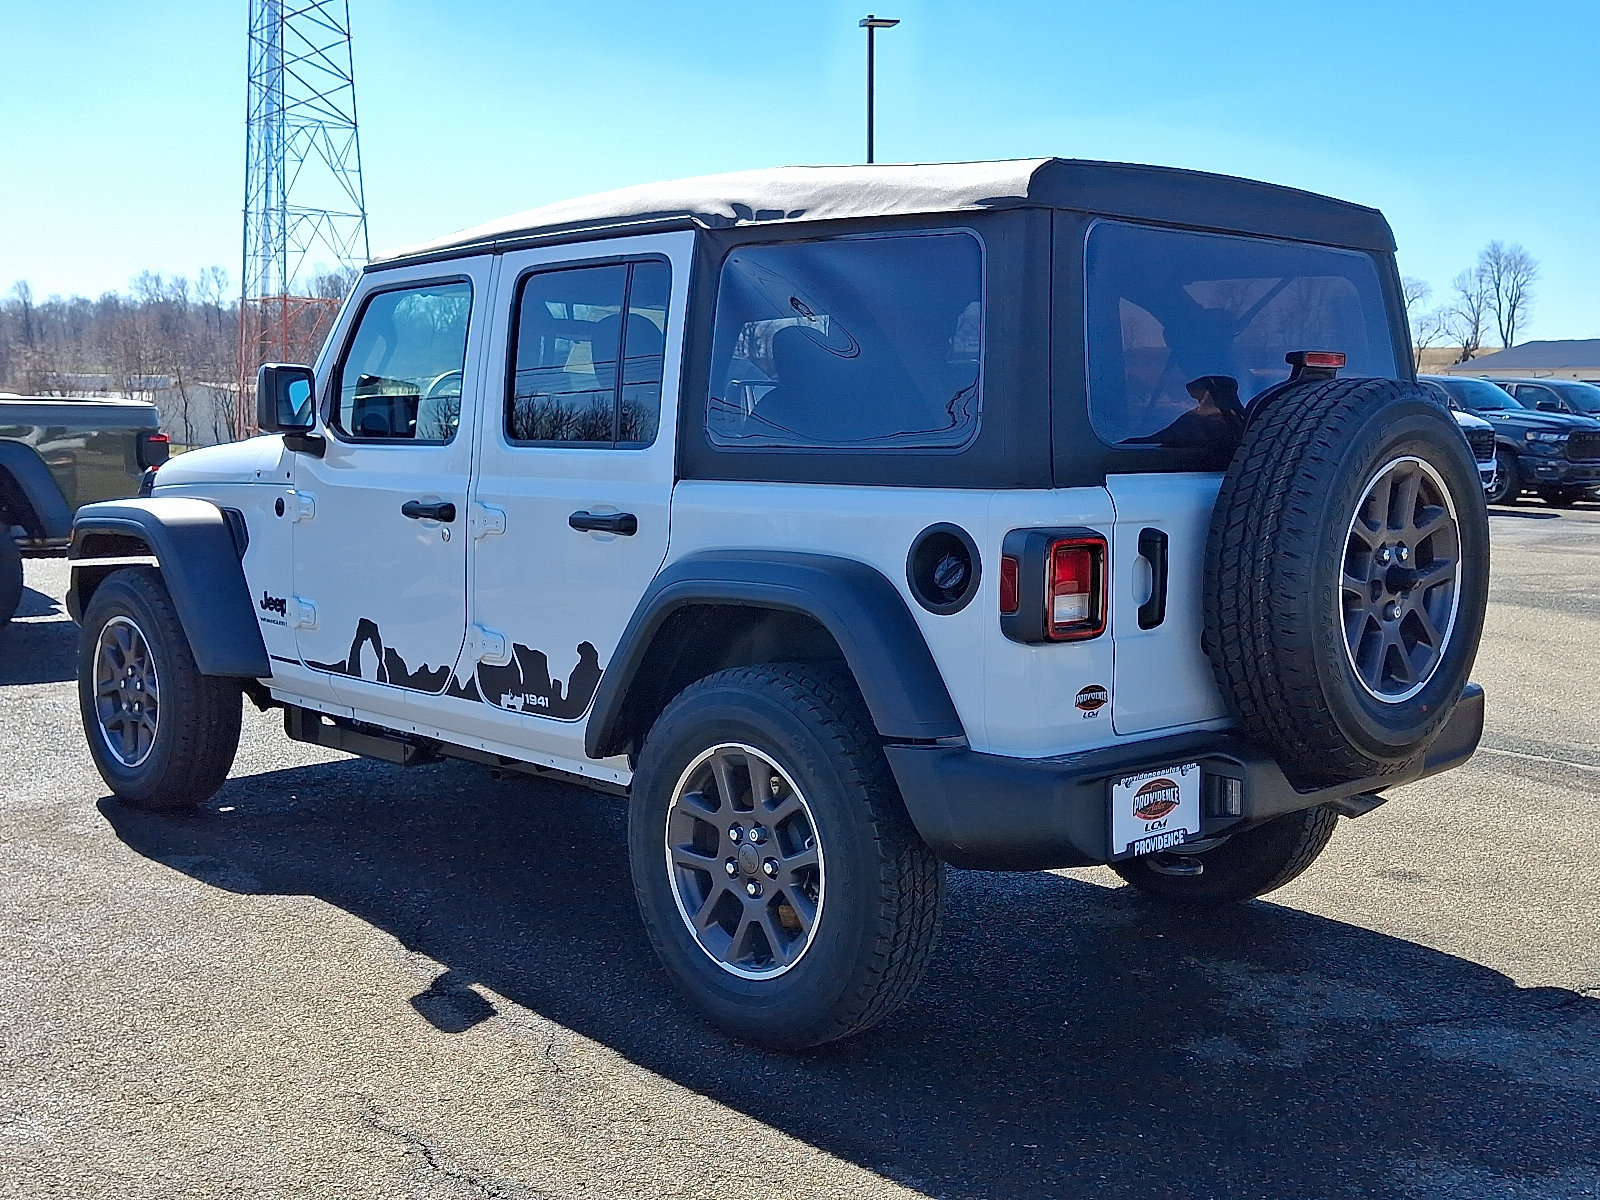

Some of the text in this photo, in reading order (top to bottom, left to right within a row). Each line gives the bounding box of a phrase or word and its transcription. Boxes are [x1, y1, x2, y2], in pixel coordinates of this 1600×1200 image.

[260, 590, 287, 617] Jeep
[525, 693, 549, 708] 1941
[1076, 691, 1107, 706] PROVIDENCE
[1133, 786, 1180, 816] PROVIDENCE
[1134, 829, 1186, 857] PROVIDENCE
